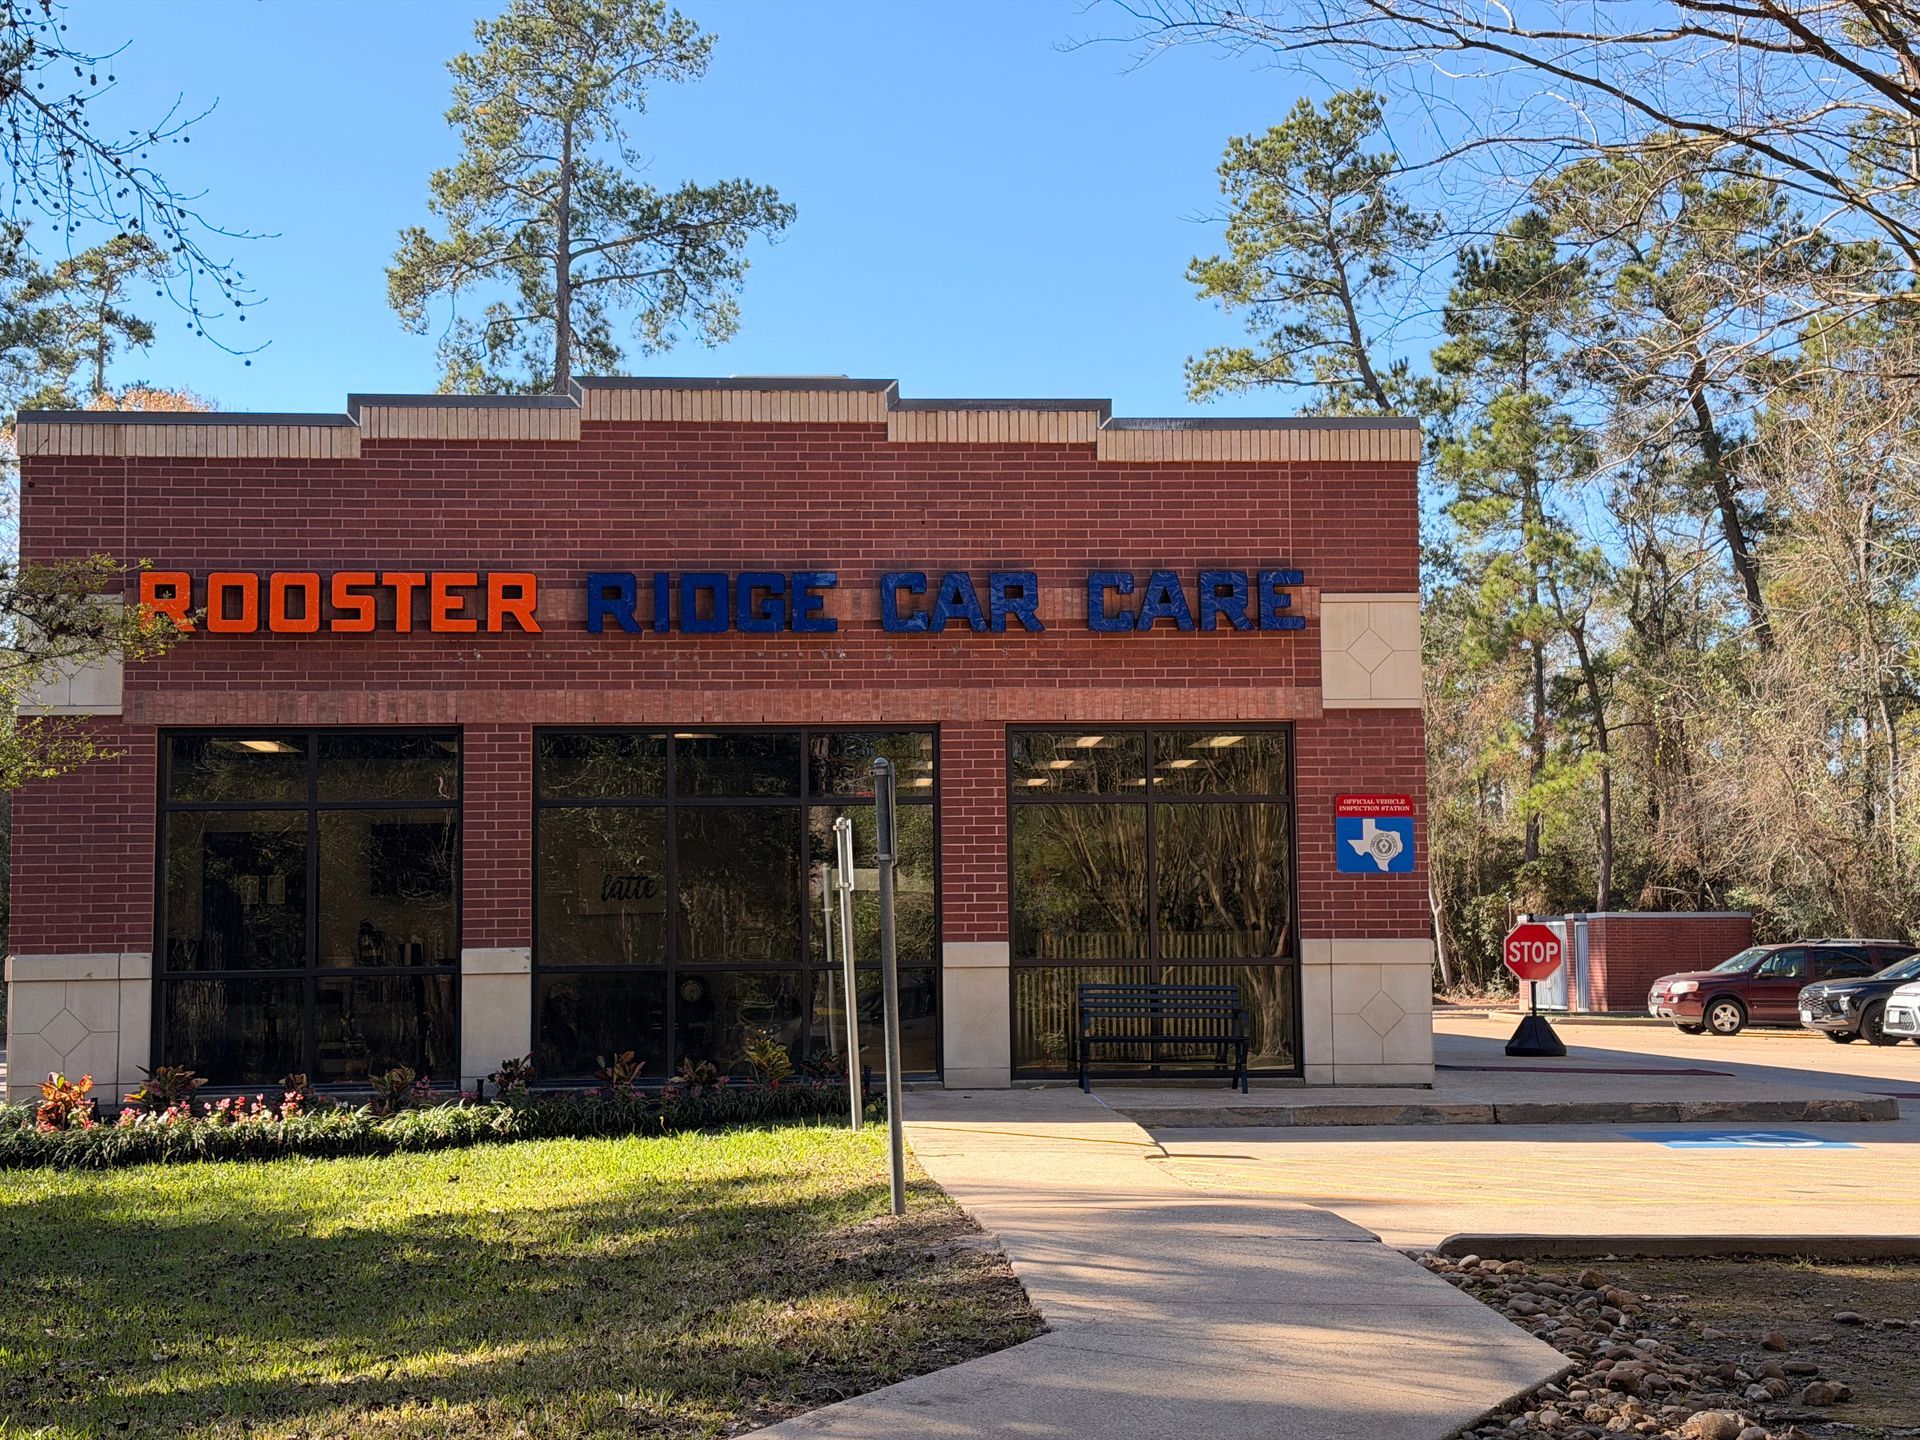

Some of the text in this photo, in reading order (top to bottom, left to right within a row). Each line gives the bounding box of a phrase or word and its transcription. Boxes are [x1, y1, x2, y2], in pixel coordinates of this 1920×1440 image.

[139, 570, 1306, 634] ROOSTER RIDGE CAR CARE
[602, 873, 658, 902] latte
[1508, 941, 1559, 963] STOP
